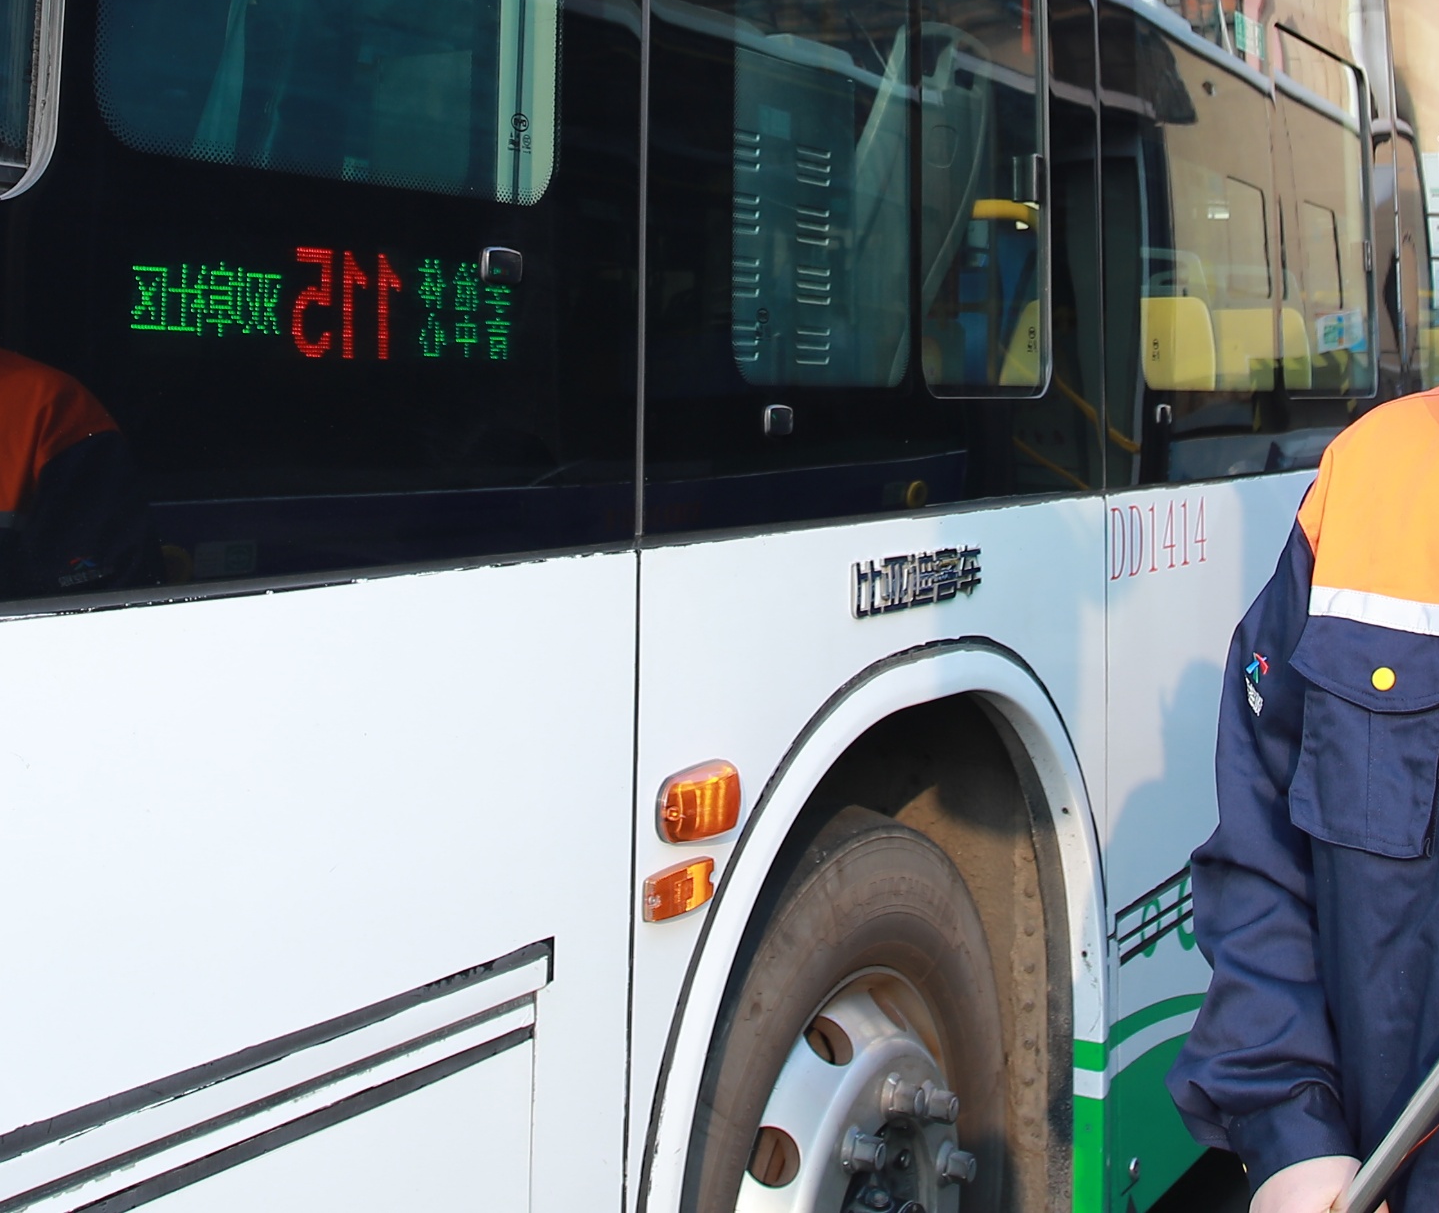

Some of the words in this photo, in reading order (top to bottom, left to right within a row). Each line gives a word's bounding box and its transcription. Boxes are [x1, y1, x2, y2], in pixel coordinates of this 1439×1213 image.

[1109, 495, 1208, 582] DD1414
[851, 544, 982, 620] 比亚迪客车
